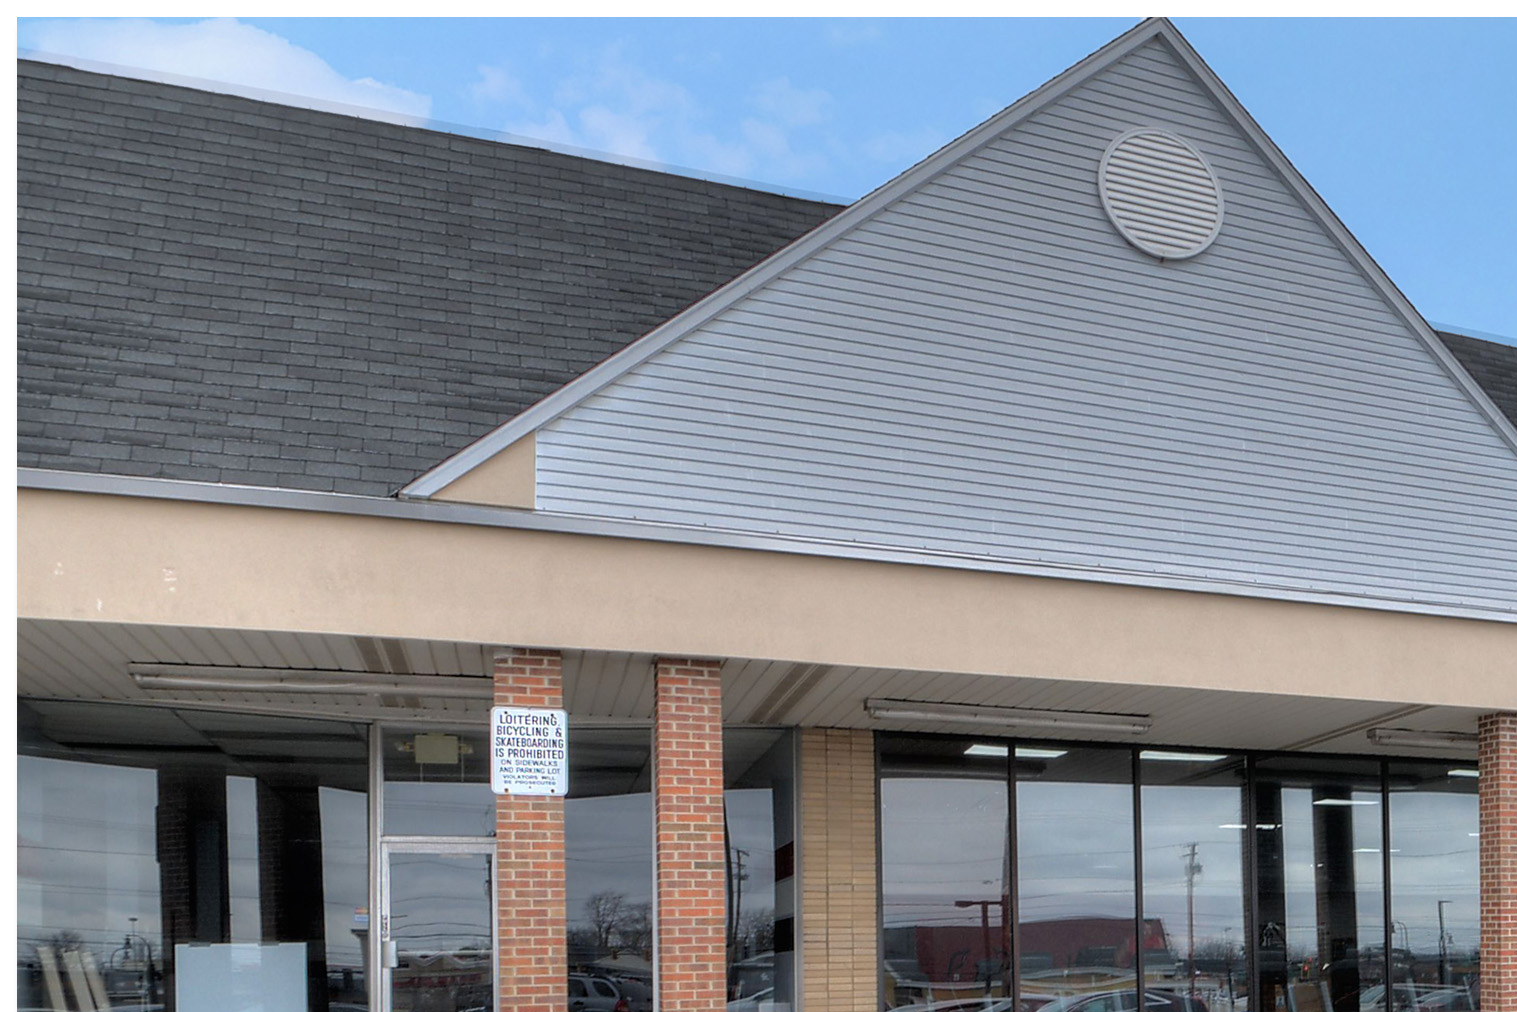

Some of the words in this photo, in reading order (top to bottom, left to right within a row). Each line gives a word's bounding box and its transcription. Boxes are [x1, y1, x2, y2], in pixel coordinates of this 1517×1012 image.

[496, 726, 549, 737] BICYCLING
[555, 727, 563, 738] &
[495, 737, 564, 749] SKATEBOARDING
[495, 748, 505, 758] IS
[507, 748, 565, 760] PROHIBITED
[515, 759, 558, 767] SIDEWALKS
